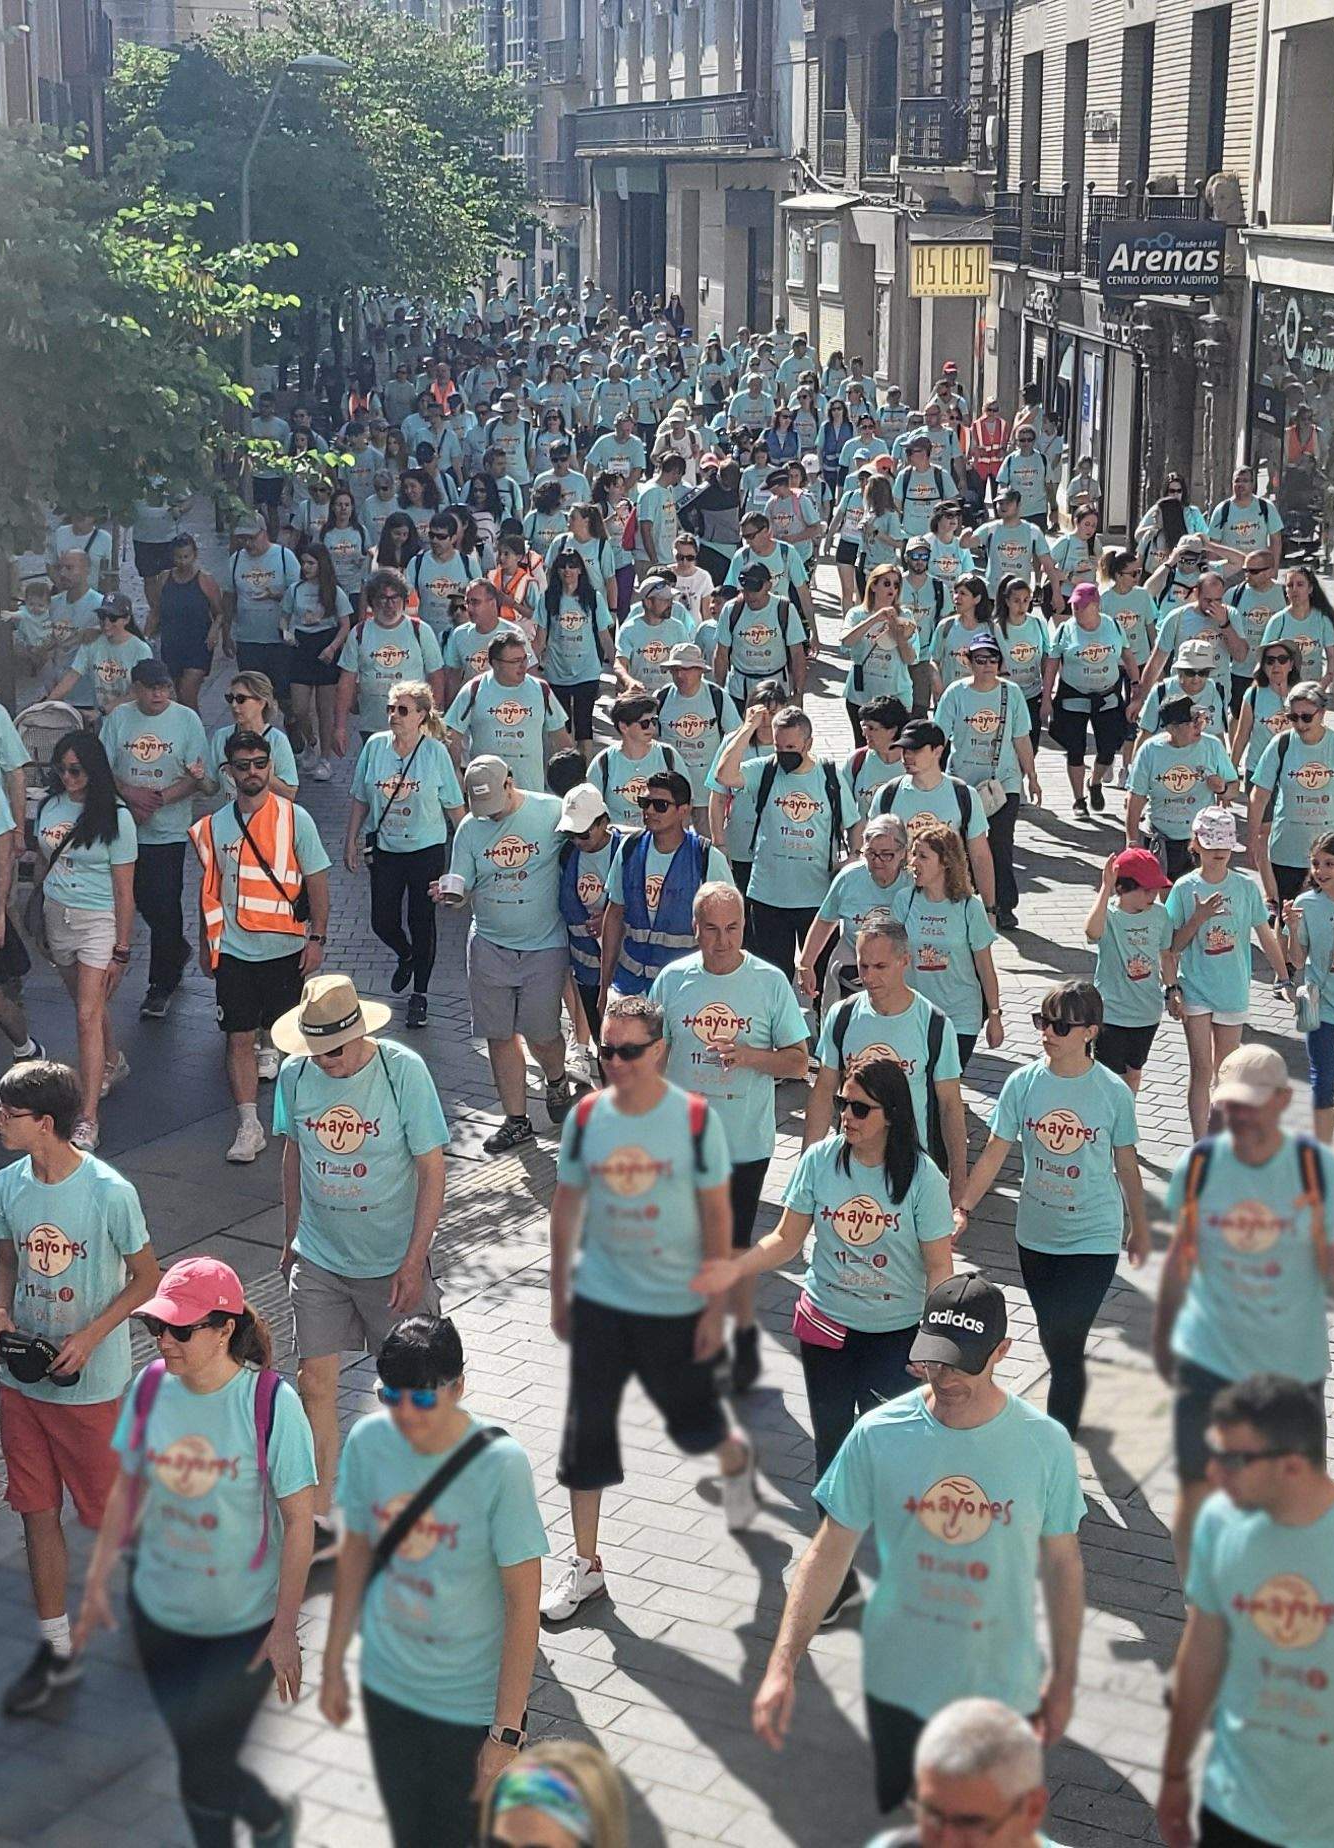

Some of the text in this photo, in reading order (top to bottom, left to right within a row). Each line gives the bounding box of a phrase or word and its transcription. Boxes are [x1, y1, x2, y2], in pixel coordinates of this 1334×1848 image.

[916, 247, 984, 285] ASCASO
[1107, 243, 1220, 273] Arenas
[1106, 273, 1219, 285] CENTRO ÓPTICO Y AUDITIVO
[738, 629, 777, 639] +mayores
[371, 650, 409, 661] +mayores
[487, 704, 532, 718] +mayores
[124, 741, 173, 753] +mayores
[483, 843, 541, 857] +mayores
[682, 1014, 752, 1034] +mayores
[305, 1118, 380, 1137] +mayores
[1026, 1118, 1101, 1142] +mayores
[316, 1161, 326, 1174] 11
[1035, 1157, 1043, 1170] 11
[821, 1207, 901, 1232] +mayores
[929, 1310, 985, 1334] adidas
[905, 1497, 1012, 1525] +mayores
